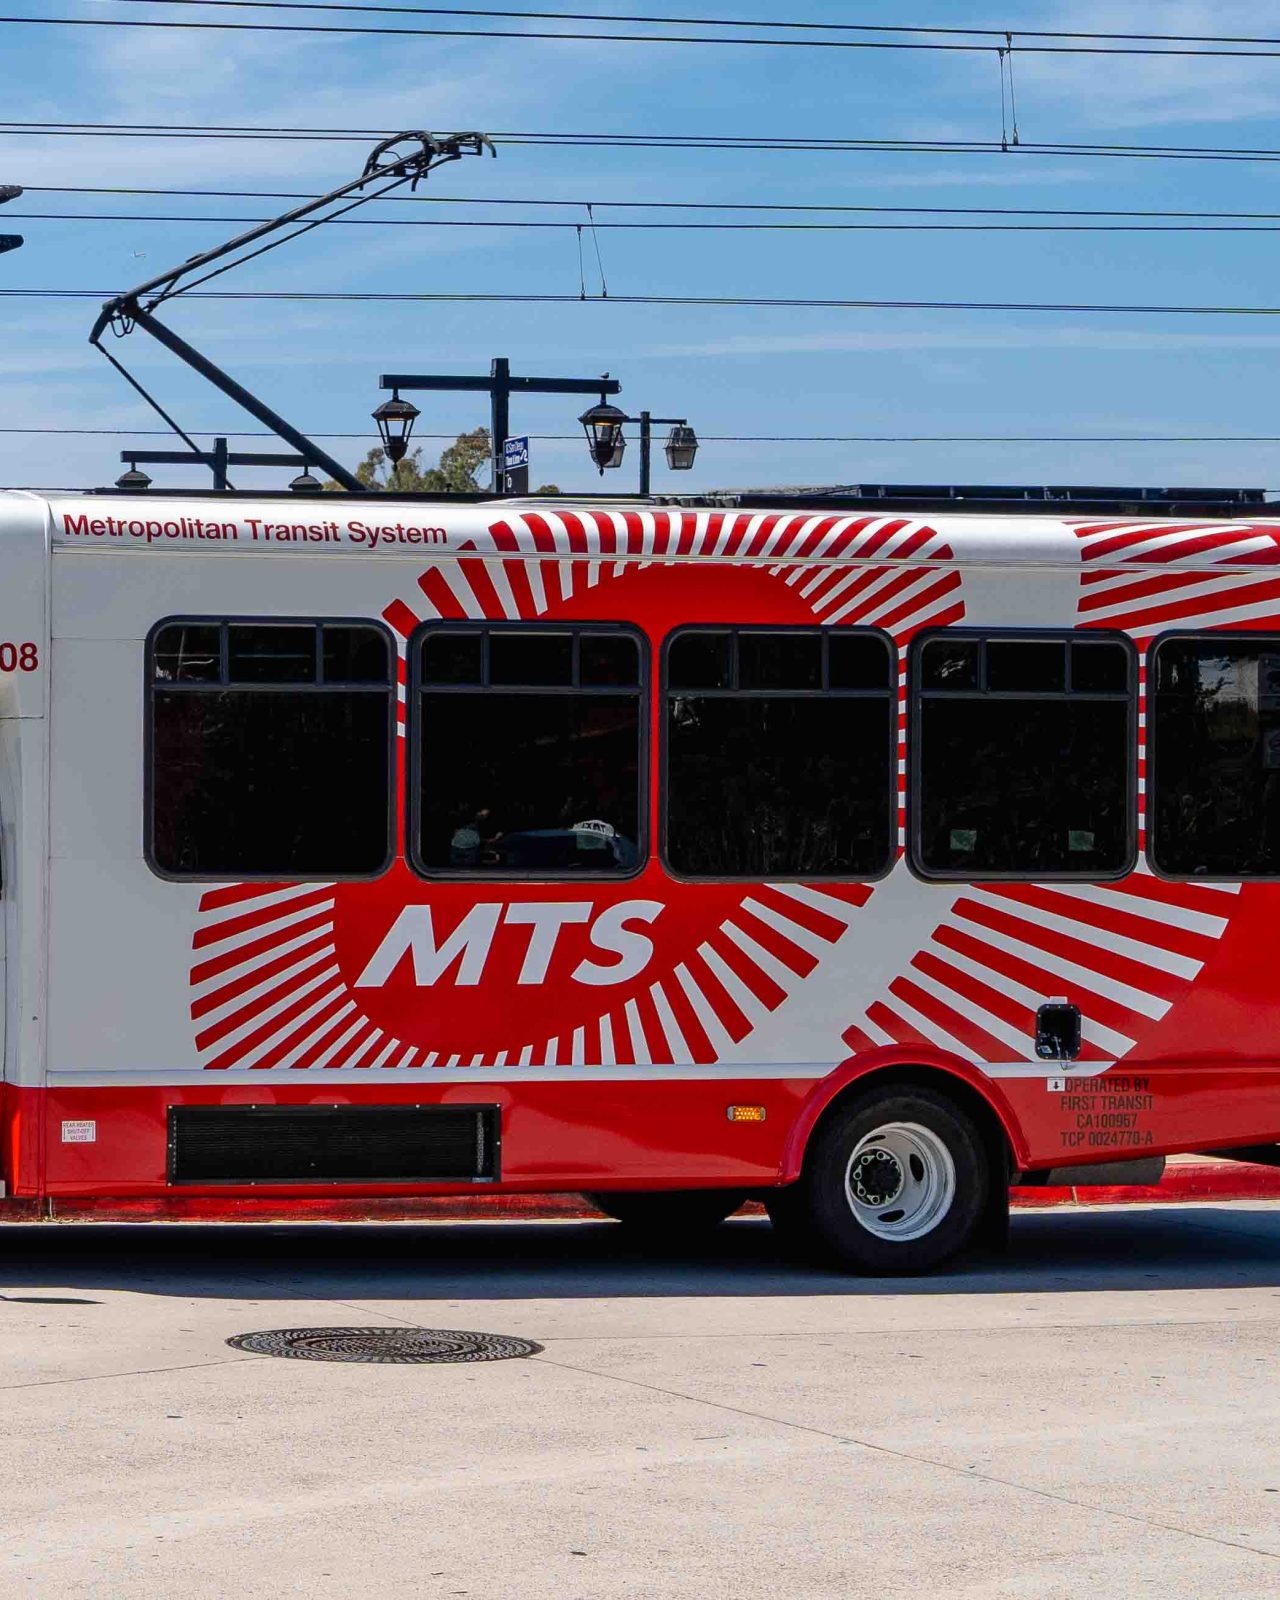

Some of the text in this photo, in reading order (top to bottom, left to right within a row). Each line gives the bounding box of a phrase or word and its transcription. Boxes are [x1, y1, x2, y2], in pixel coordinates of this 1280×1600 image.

[63, 514, 448, 548] Metropolitan Transit System
[354, 900, 665, 987] MTS
[1066, 1077, 1149, 1092] OPERATED BY
[1060, 1096, 1153, 1110] FIRST TRANSIT
[1060, 1132, 1085, 1146] TCP
